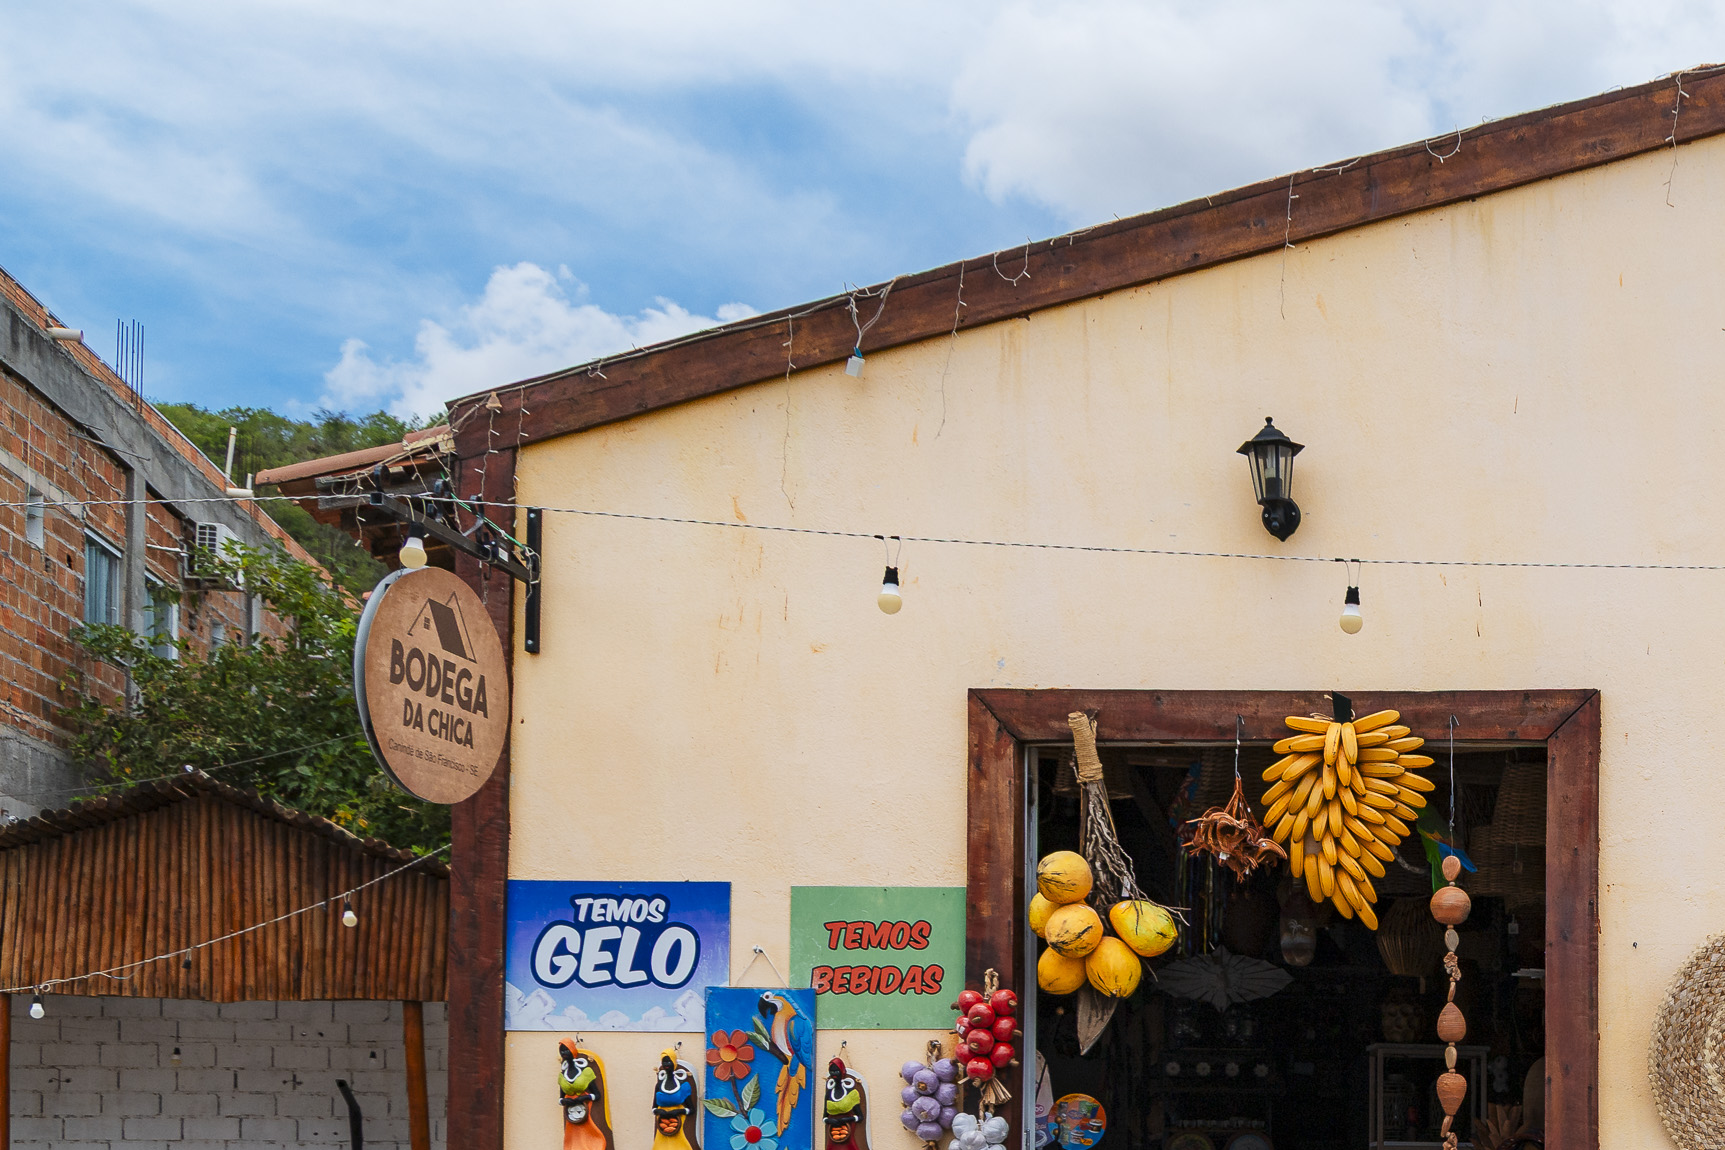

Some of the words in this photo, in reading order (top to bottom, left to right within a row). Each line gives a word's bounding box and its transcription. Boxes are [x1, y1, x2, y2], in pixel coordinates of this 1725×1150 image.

[389, 638, 489, 719] BODEGA
[403, 697, 424, 732] DA
[428, 708, 474, 749] CHICA
[415, 747, 423, 759] de
[424, 749, 437, 763] São
[437, 753, 465, 772] Francisco
[469, 764, 479, 776] SE
[574, 897, 667, 924] TEMOS
[824, 920, 932, 950] TEMOS
[532, 924, 699, 986] GELO
[810, 964, 944, 995] BEBIDAS
